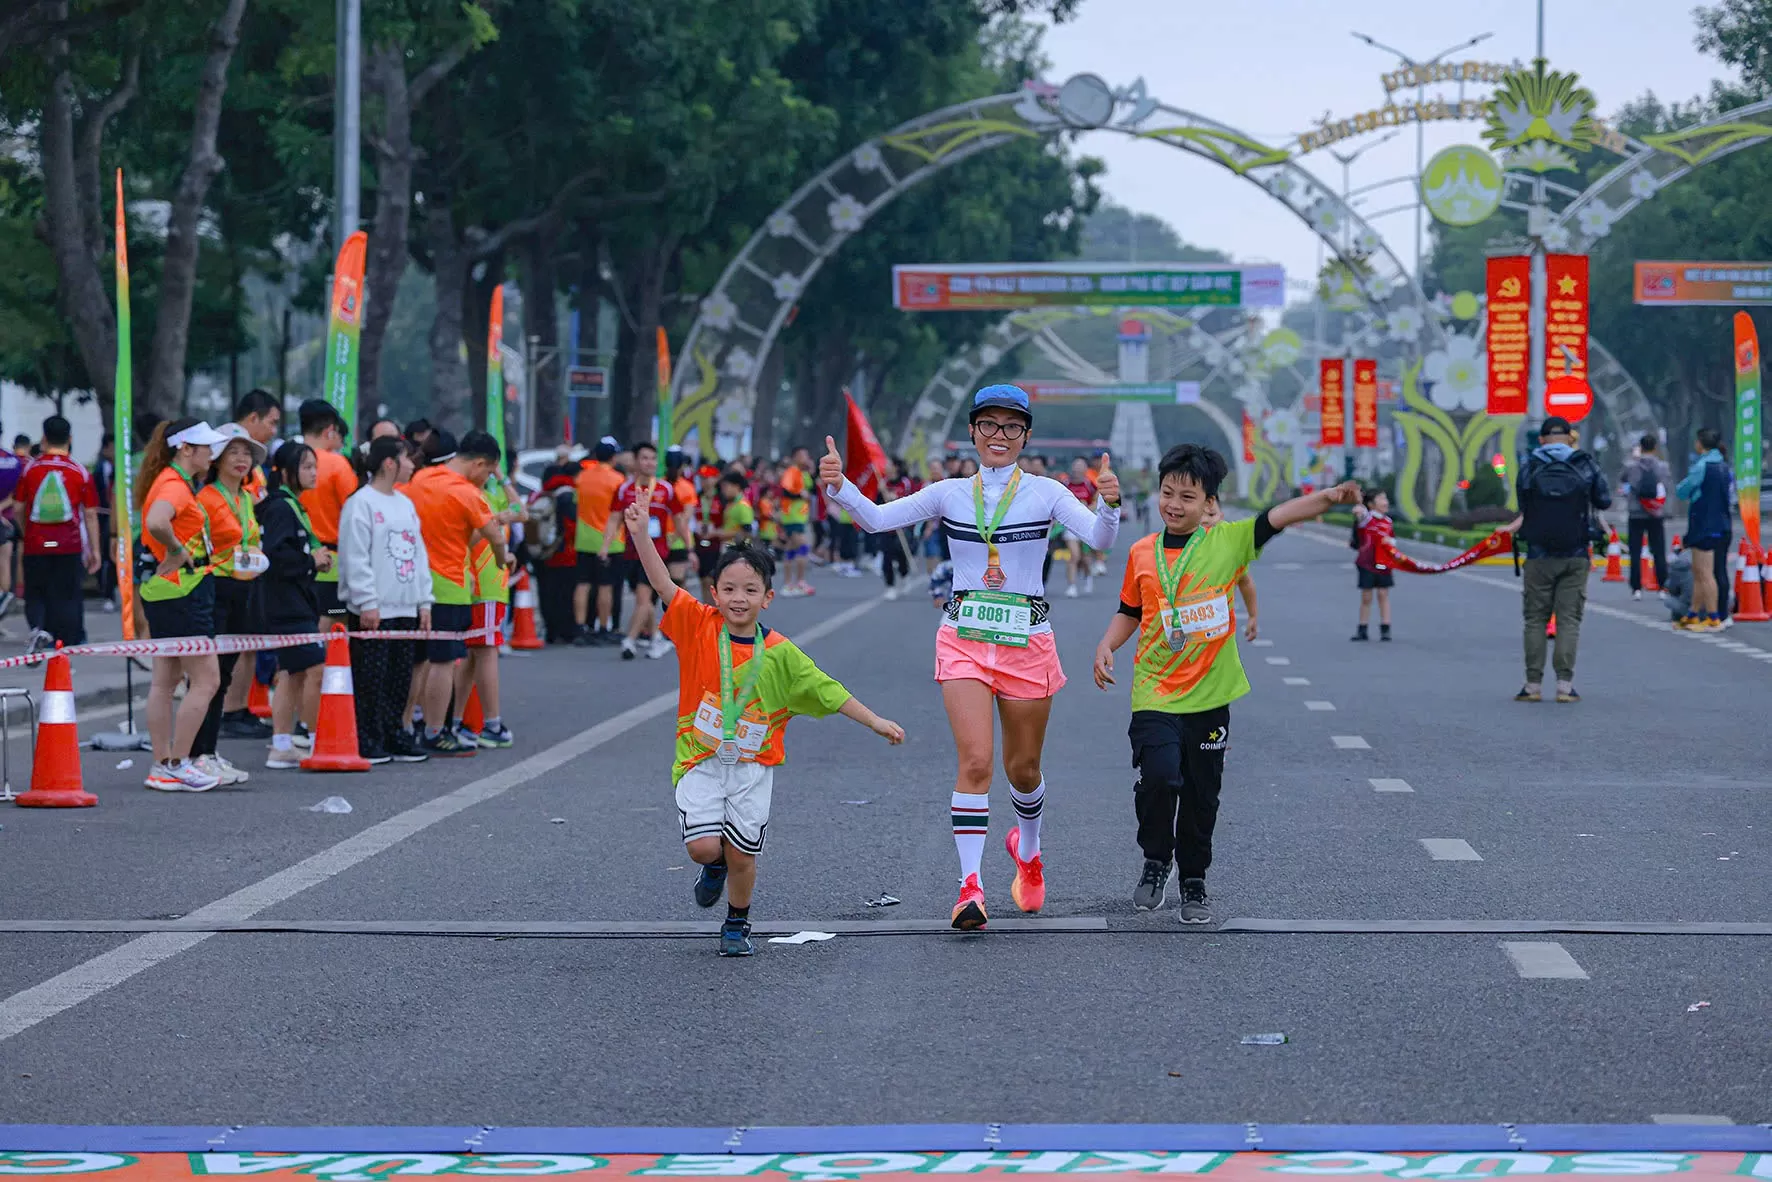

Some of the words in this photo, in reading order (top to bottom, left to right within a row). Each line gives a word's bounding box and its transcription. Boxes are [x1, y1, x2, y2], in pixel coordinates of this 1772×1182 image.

[1012, 530, 1041, 541] RUNNING
[977, 605, 1011, 623] 8081
[1180, 604, 1215, 625] 5493
